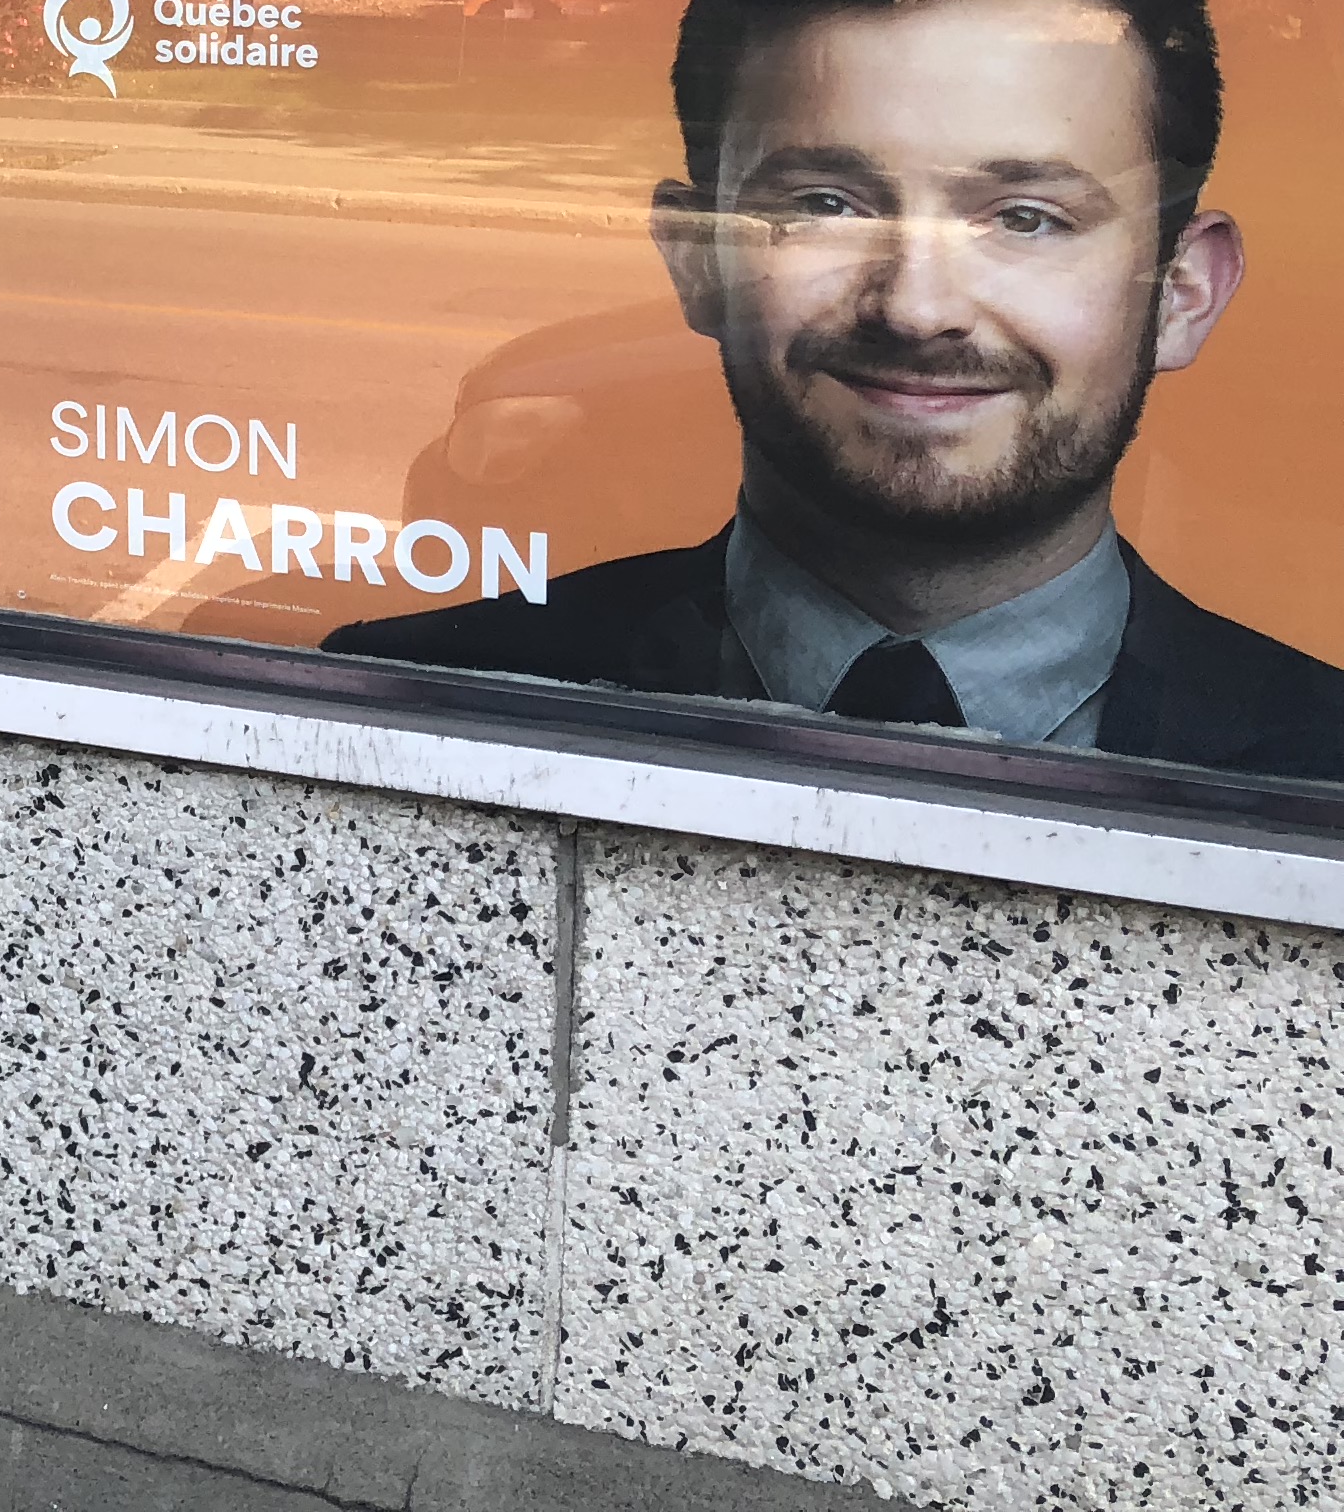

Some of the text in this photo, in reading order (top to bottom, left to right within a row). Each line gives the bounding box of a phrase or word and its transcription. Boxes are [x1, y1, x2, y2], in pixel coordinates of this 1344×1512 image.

[155, 32, 318, 68] solidaire
[50, 400, 297, 480] SIMON
[51, 480, 548, 606] CHARRON
